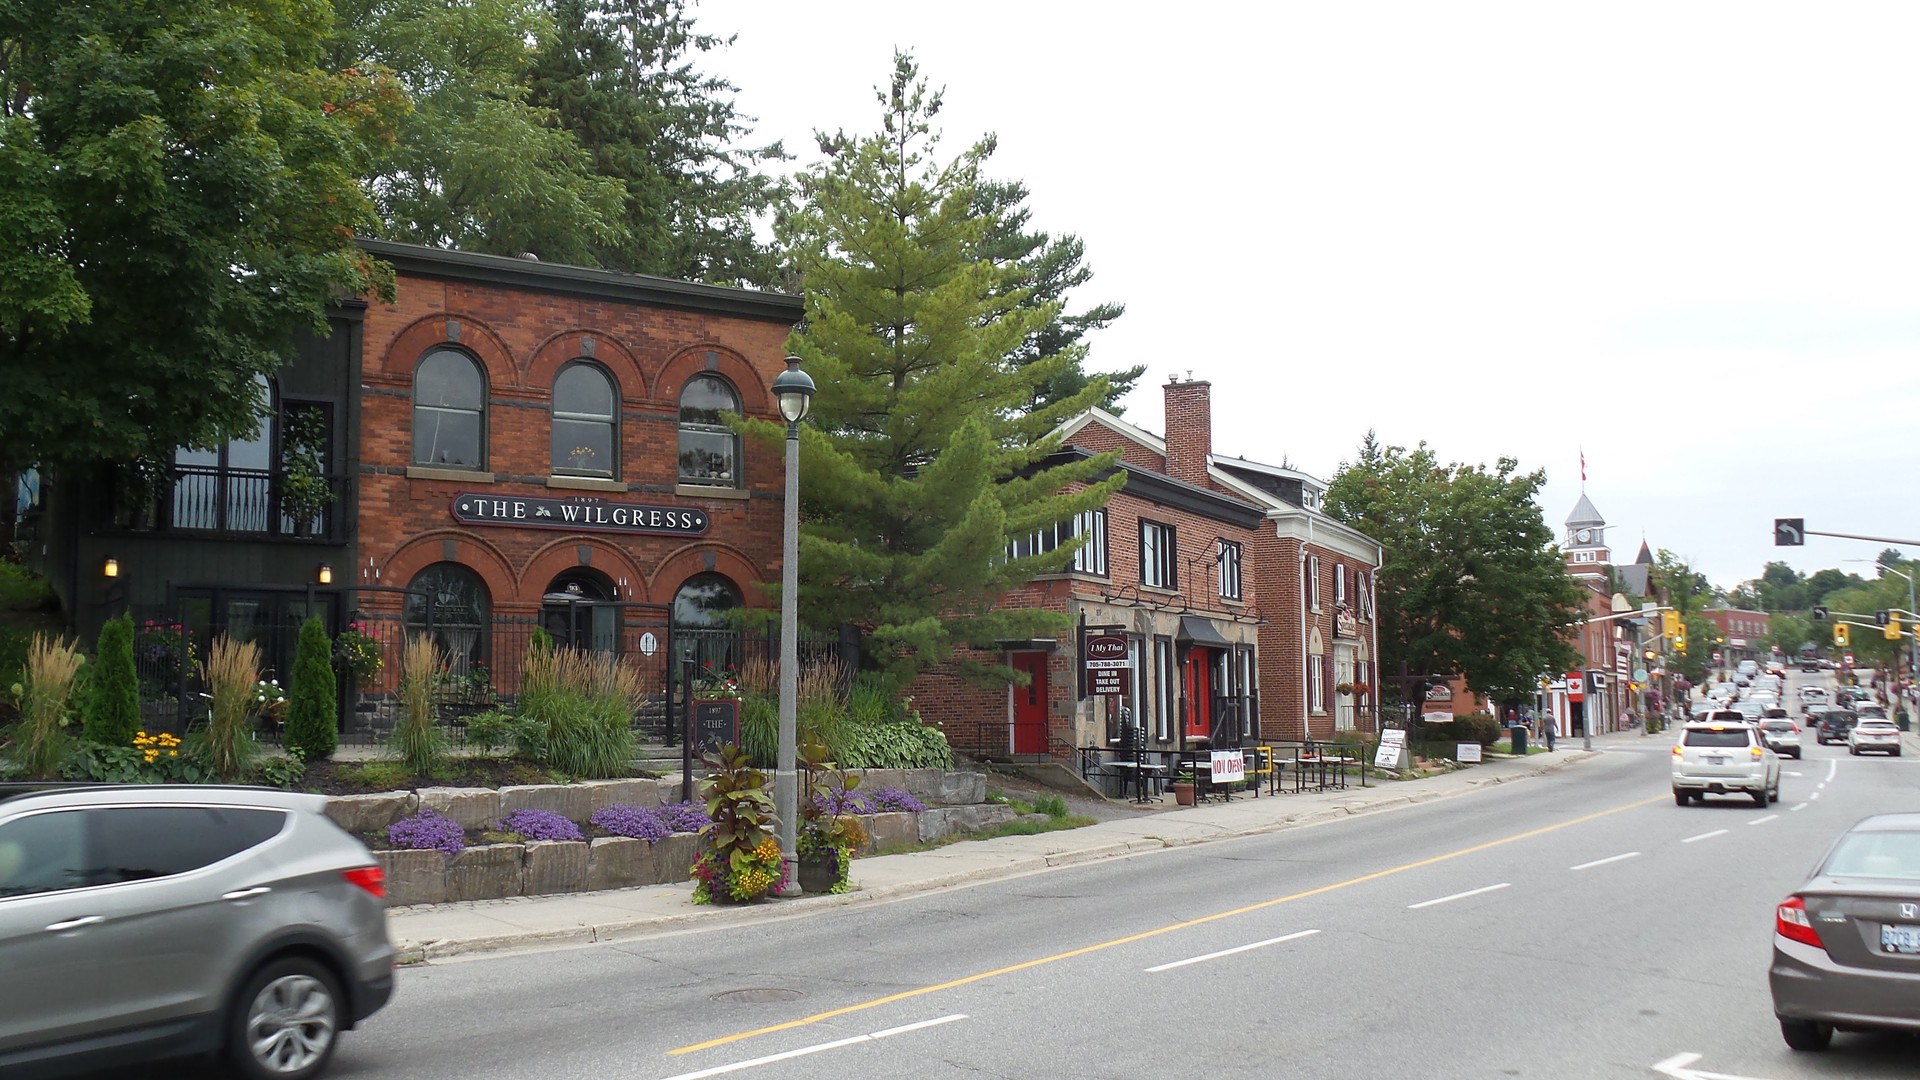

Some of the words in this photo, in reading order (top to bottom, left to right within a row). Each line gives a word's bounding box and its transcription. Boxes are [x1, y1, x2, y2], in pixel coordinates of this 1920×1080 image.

[574, 496, 600, 504] 1897
[474, 499, 526, 519] THE
[561, 504, 692, 529] WILGRESS
[1096, 645, 1106, 653] My
[705, 719, 724, 729] THE
[1228, 759, 1242, 773] OPEN
